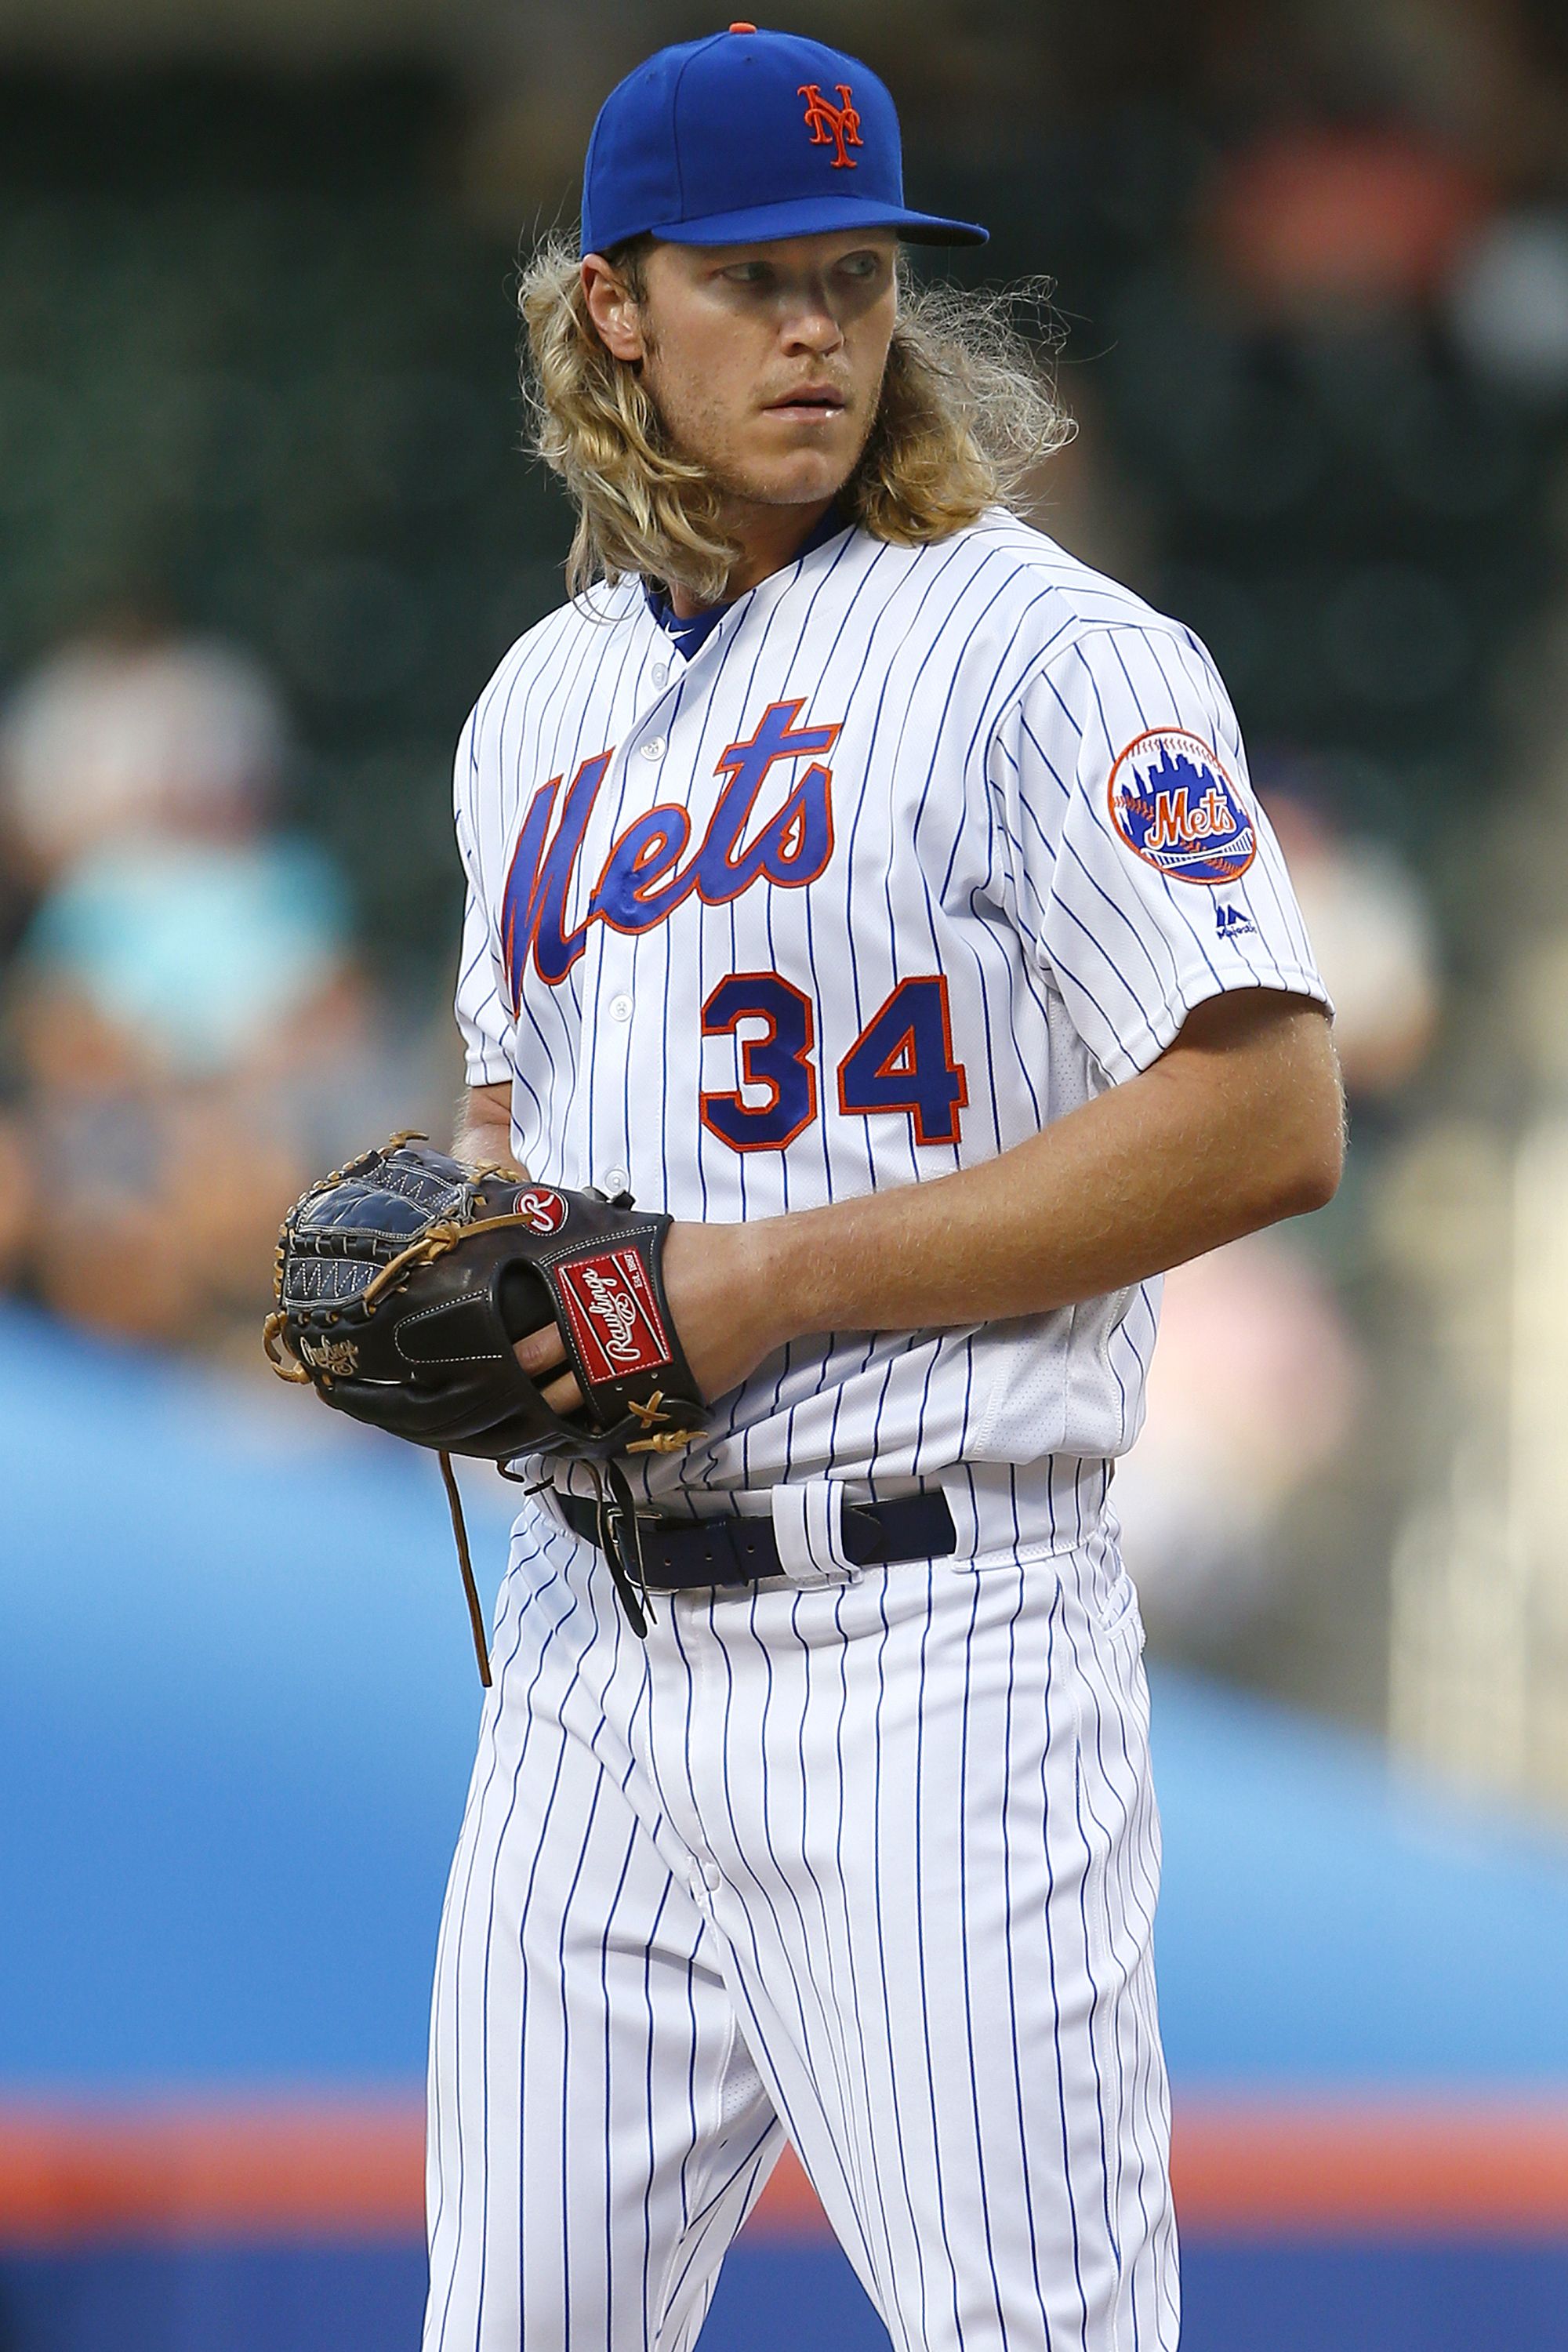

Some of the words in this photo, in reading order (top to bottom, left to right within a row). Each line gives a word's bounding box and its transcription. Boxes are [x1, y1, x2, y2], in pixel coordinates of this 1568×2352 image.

[501, 696, 843, 1022] Mets
[1143, 786, 1236, 850] Mets
[699, 971, 968, 1152] 34
[582, 1268, 641, 1361] Rawlings
